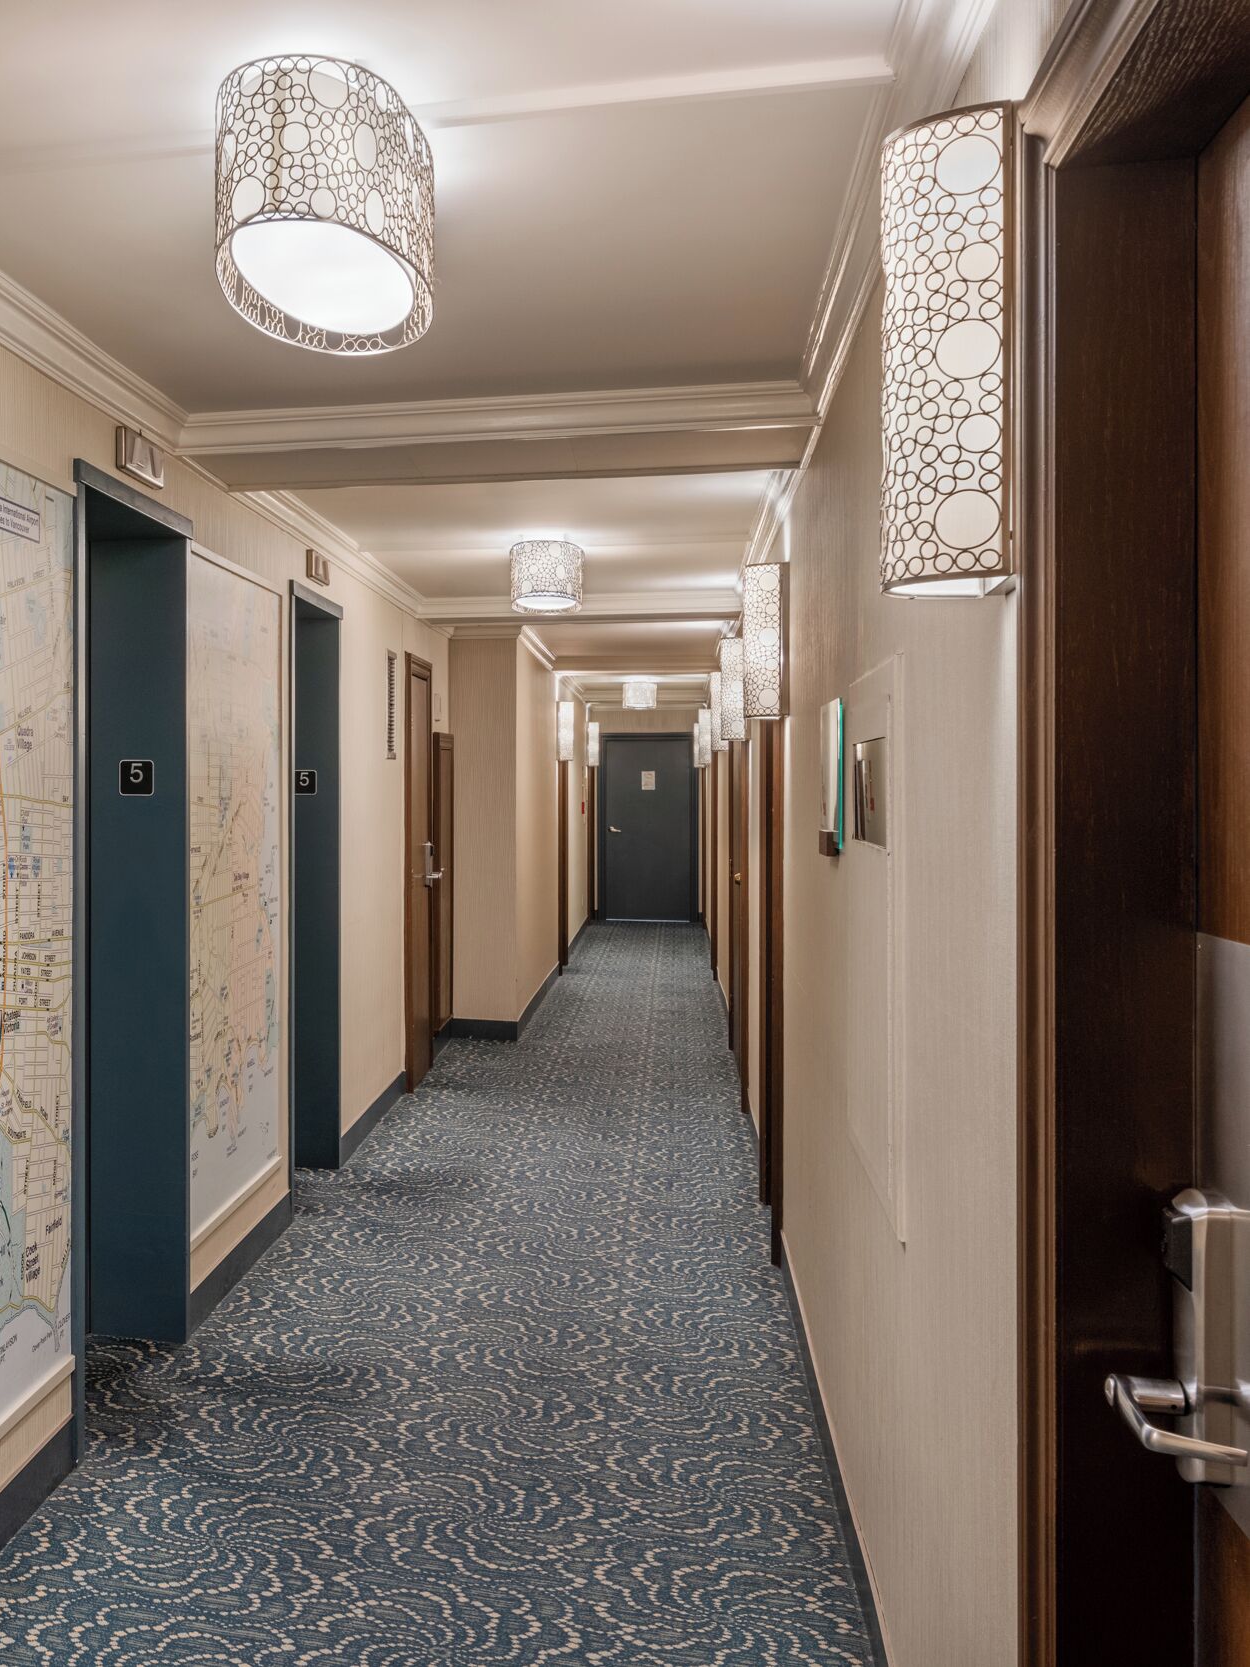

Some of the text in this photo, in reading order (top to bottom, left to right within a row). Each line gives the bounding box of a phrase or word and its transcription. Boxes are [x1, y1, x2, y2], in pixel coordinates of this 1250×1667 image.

[2, 503, 25, 522] International
[26, 514, 39, 528] Airport
[10, 520, 30, 535] Vancouver
[17, 724, 34, 737] Quadra
[130, 763, 144, 783] 5
[299, 772, 309, 786] 5
[19, 931, 35, 940] PANDORA
[40, 969, 53, 977] STREET
[3, 1009, 21, 1023] Chateau
[3, 1020, 20, 1034] Victoria
